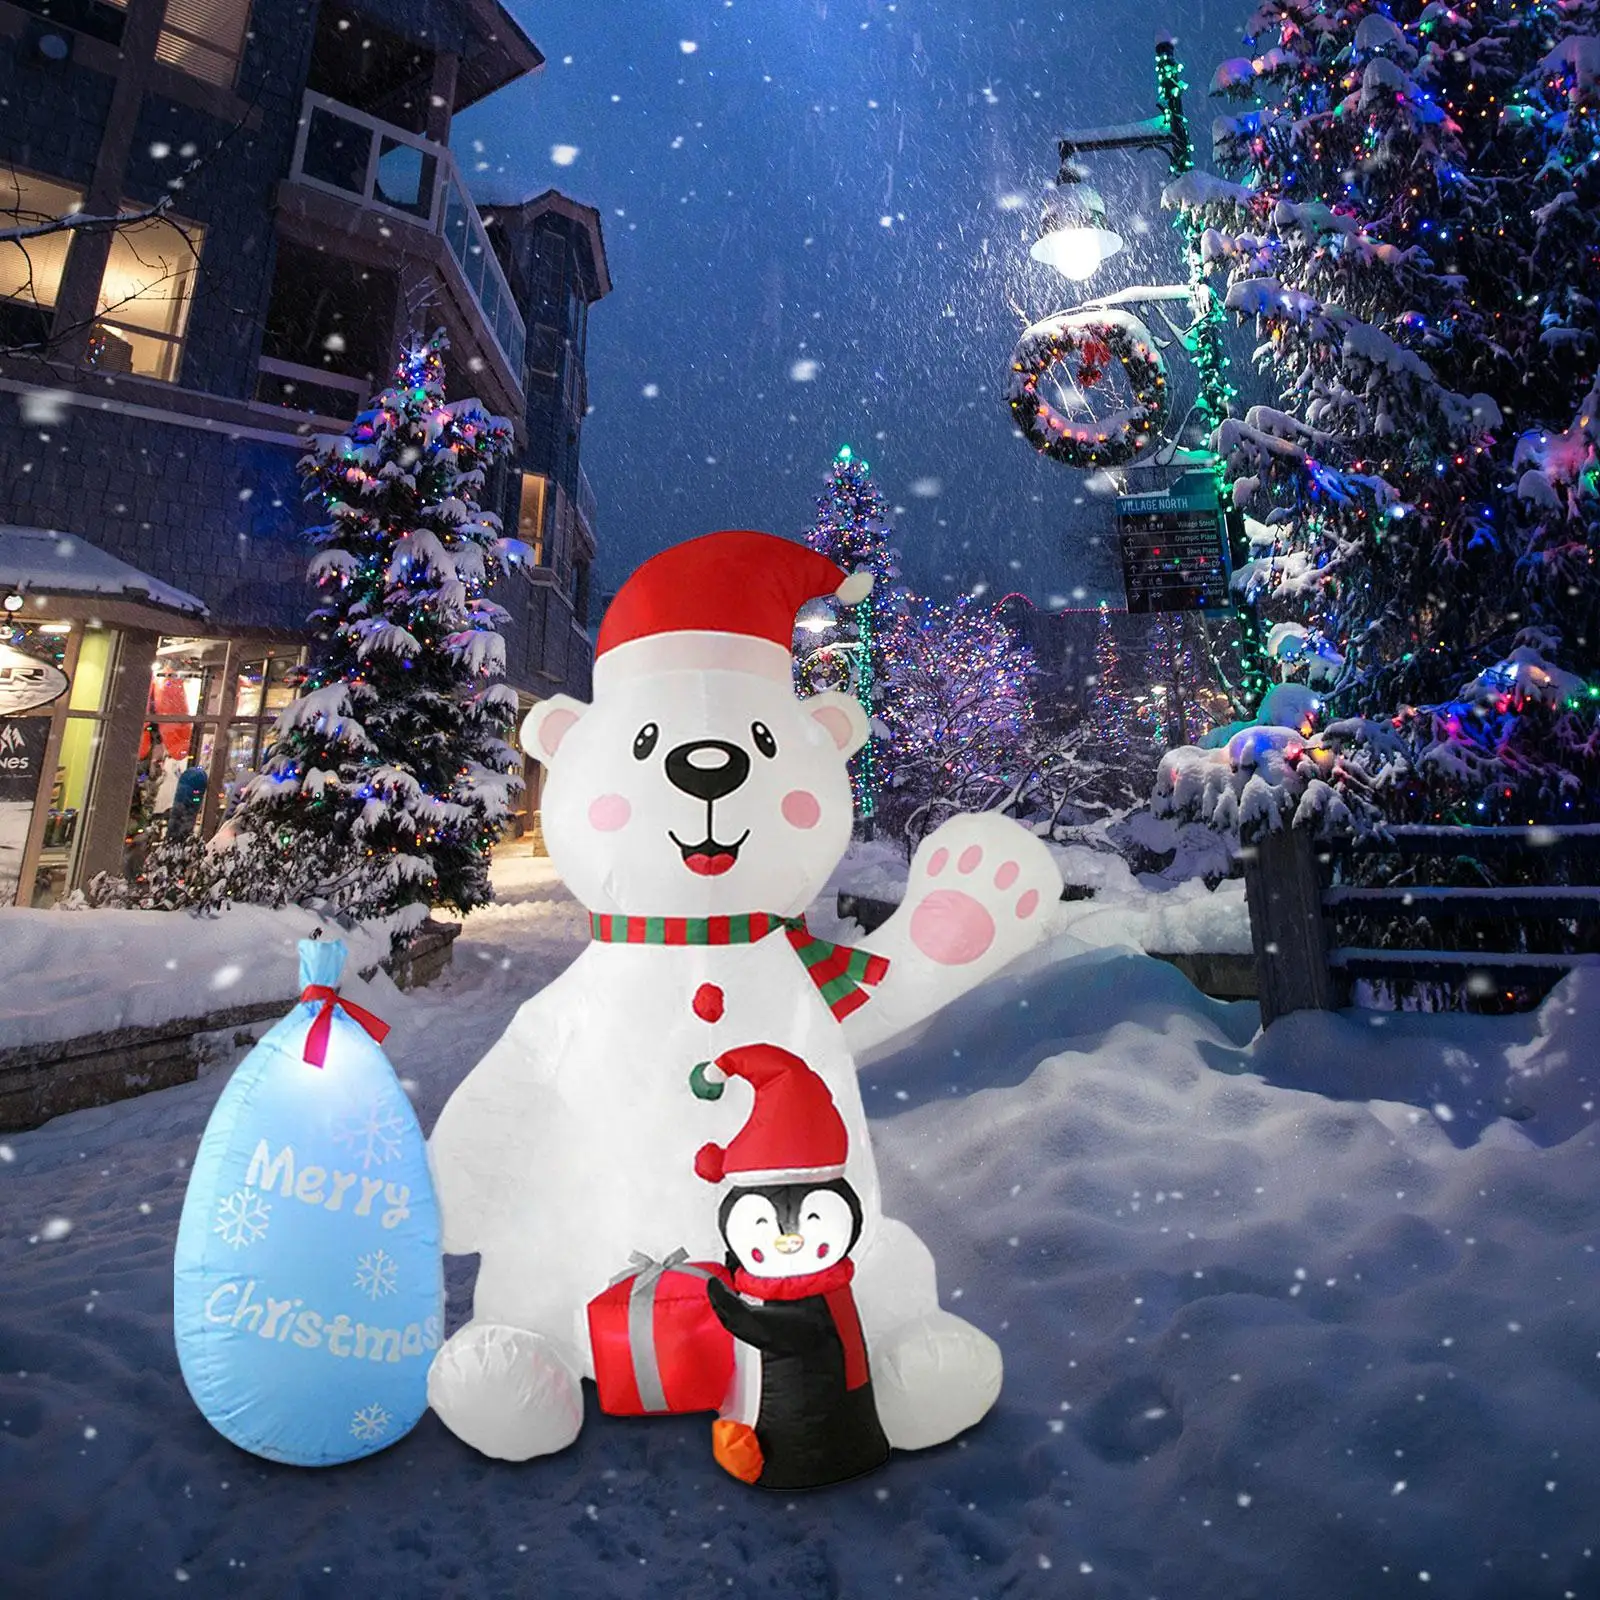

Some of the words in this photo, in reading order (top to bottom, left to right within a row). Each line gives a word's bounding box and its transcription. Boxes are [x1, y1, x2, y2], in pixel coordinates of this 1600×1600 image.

[1121, 500, 1158, 512] VILLAGE
[1159, 498, 1188, 509] NORTH
[1175, 535, 1199, 543] Olympic
[245, 1138, 410, 1229] Merry
[205, 1279, 440, 1364] Christmas
